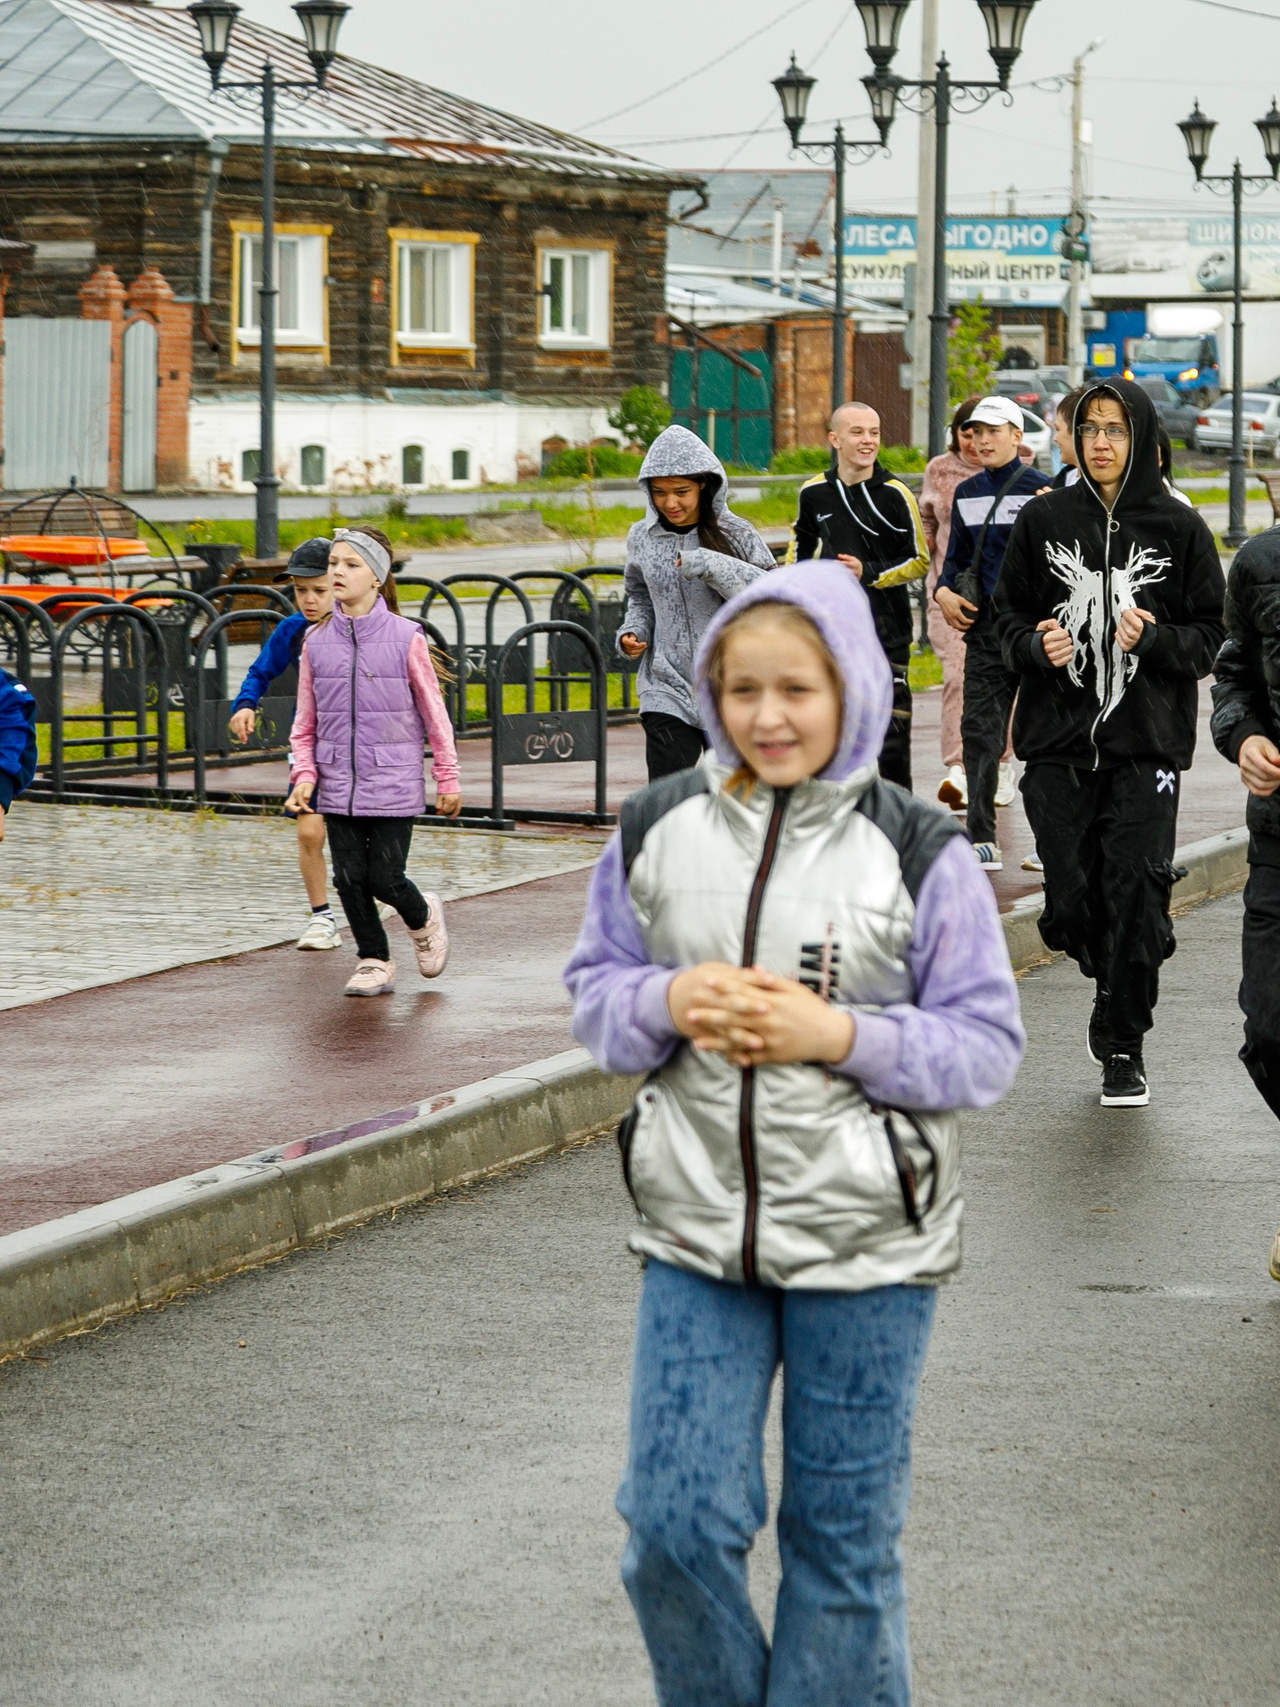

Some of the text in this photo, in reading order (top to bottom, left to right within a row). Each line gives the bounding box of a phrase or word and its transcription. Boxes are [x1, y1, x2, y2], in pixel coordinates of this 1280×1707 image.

[842, 224, 1049, 249] ЛЕСА ЫГОДНО
[995, 264, 1056, 282] ЦЕНТР
